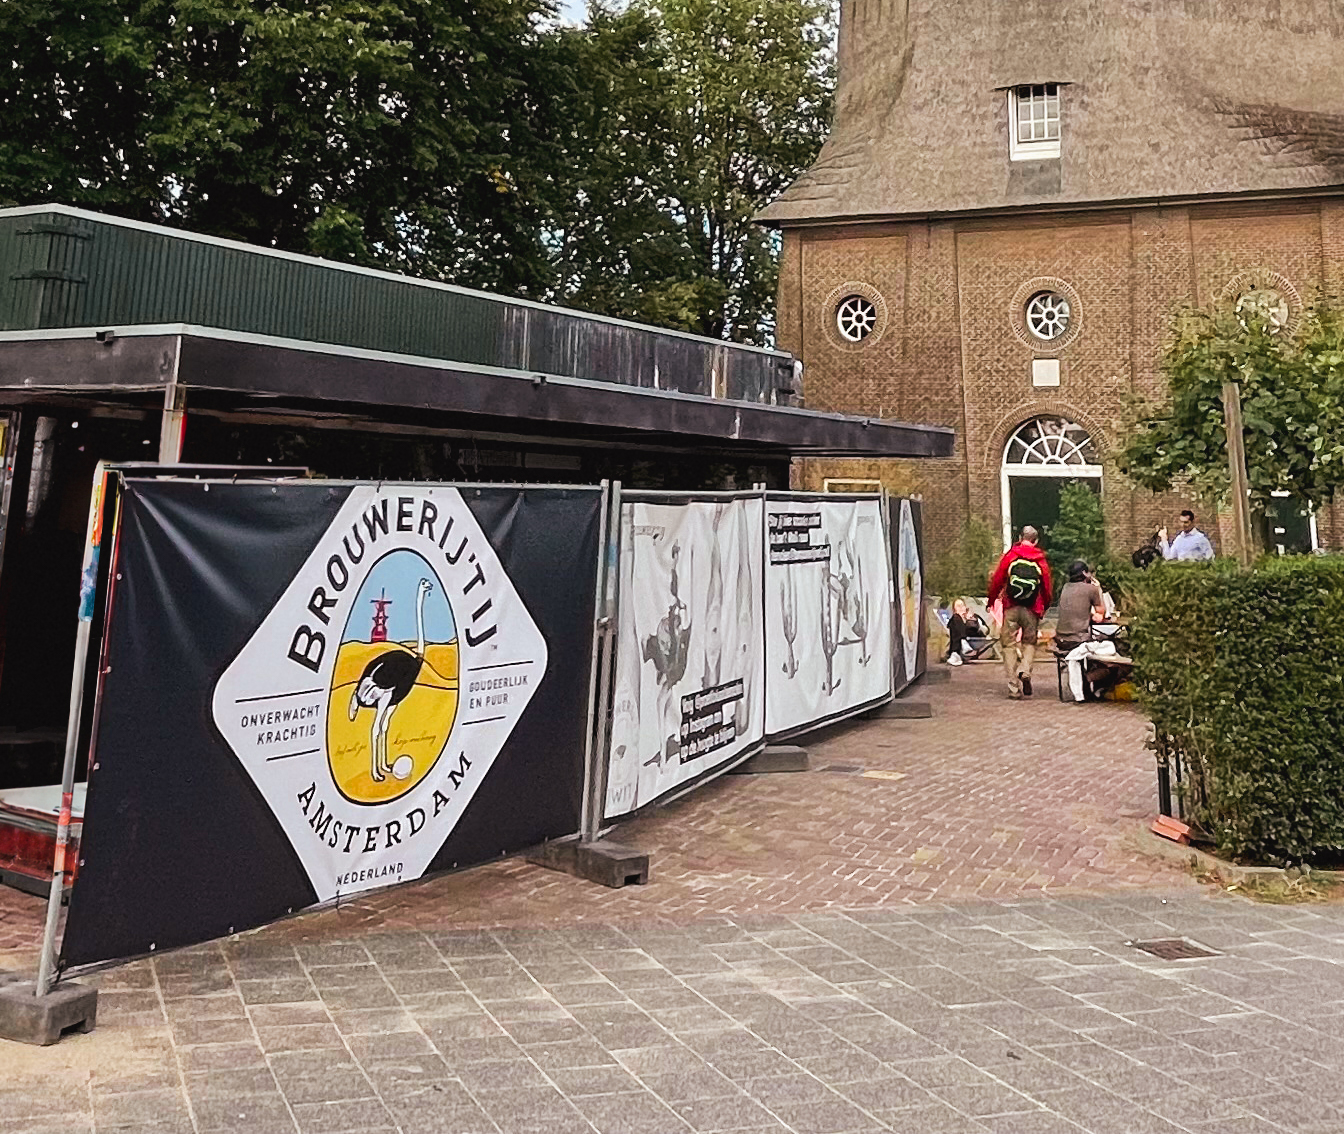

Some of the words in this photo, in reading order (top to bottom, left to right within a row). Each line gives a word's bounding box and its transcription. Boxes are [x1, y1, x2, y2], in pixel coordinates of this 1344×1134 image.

[468, 674, 529, 693] GOUDEERLIJK
[468, 696, 482, 709] EN
[486, 693, 509, 707] PUUR
[241, 704, 321, 728] ONVERWACHT
[256, 724, 317, 746] KRACHTIG
[297, 750, 474, 854] AMSTERDAM
[336, 862, 404, 887] NEDERLAND
